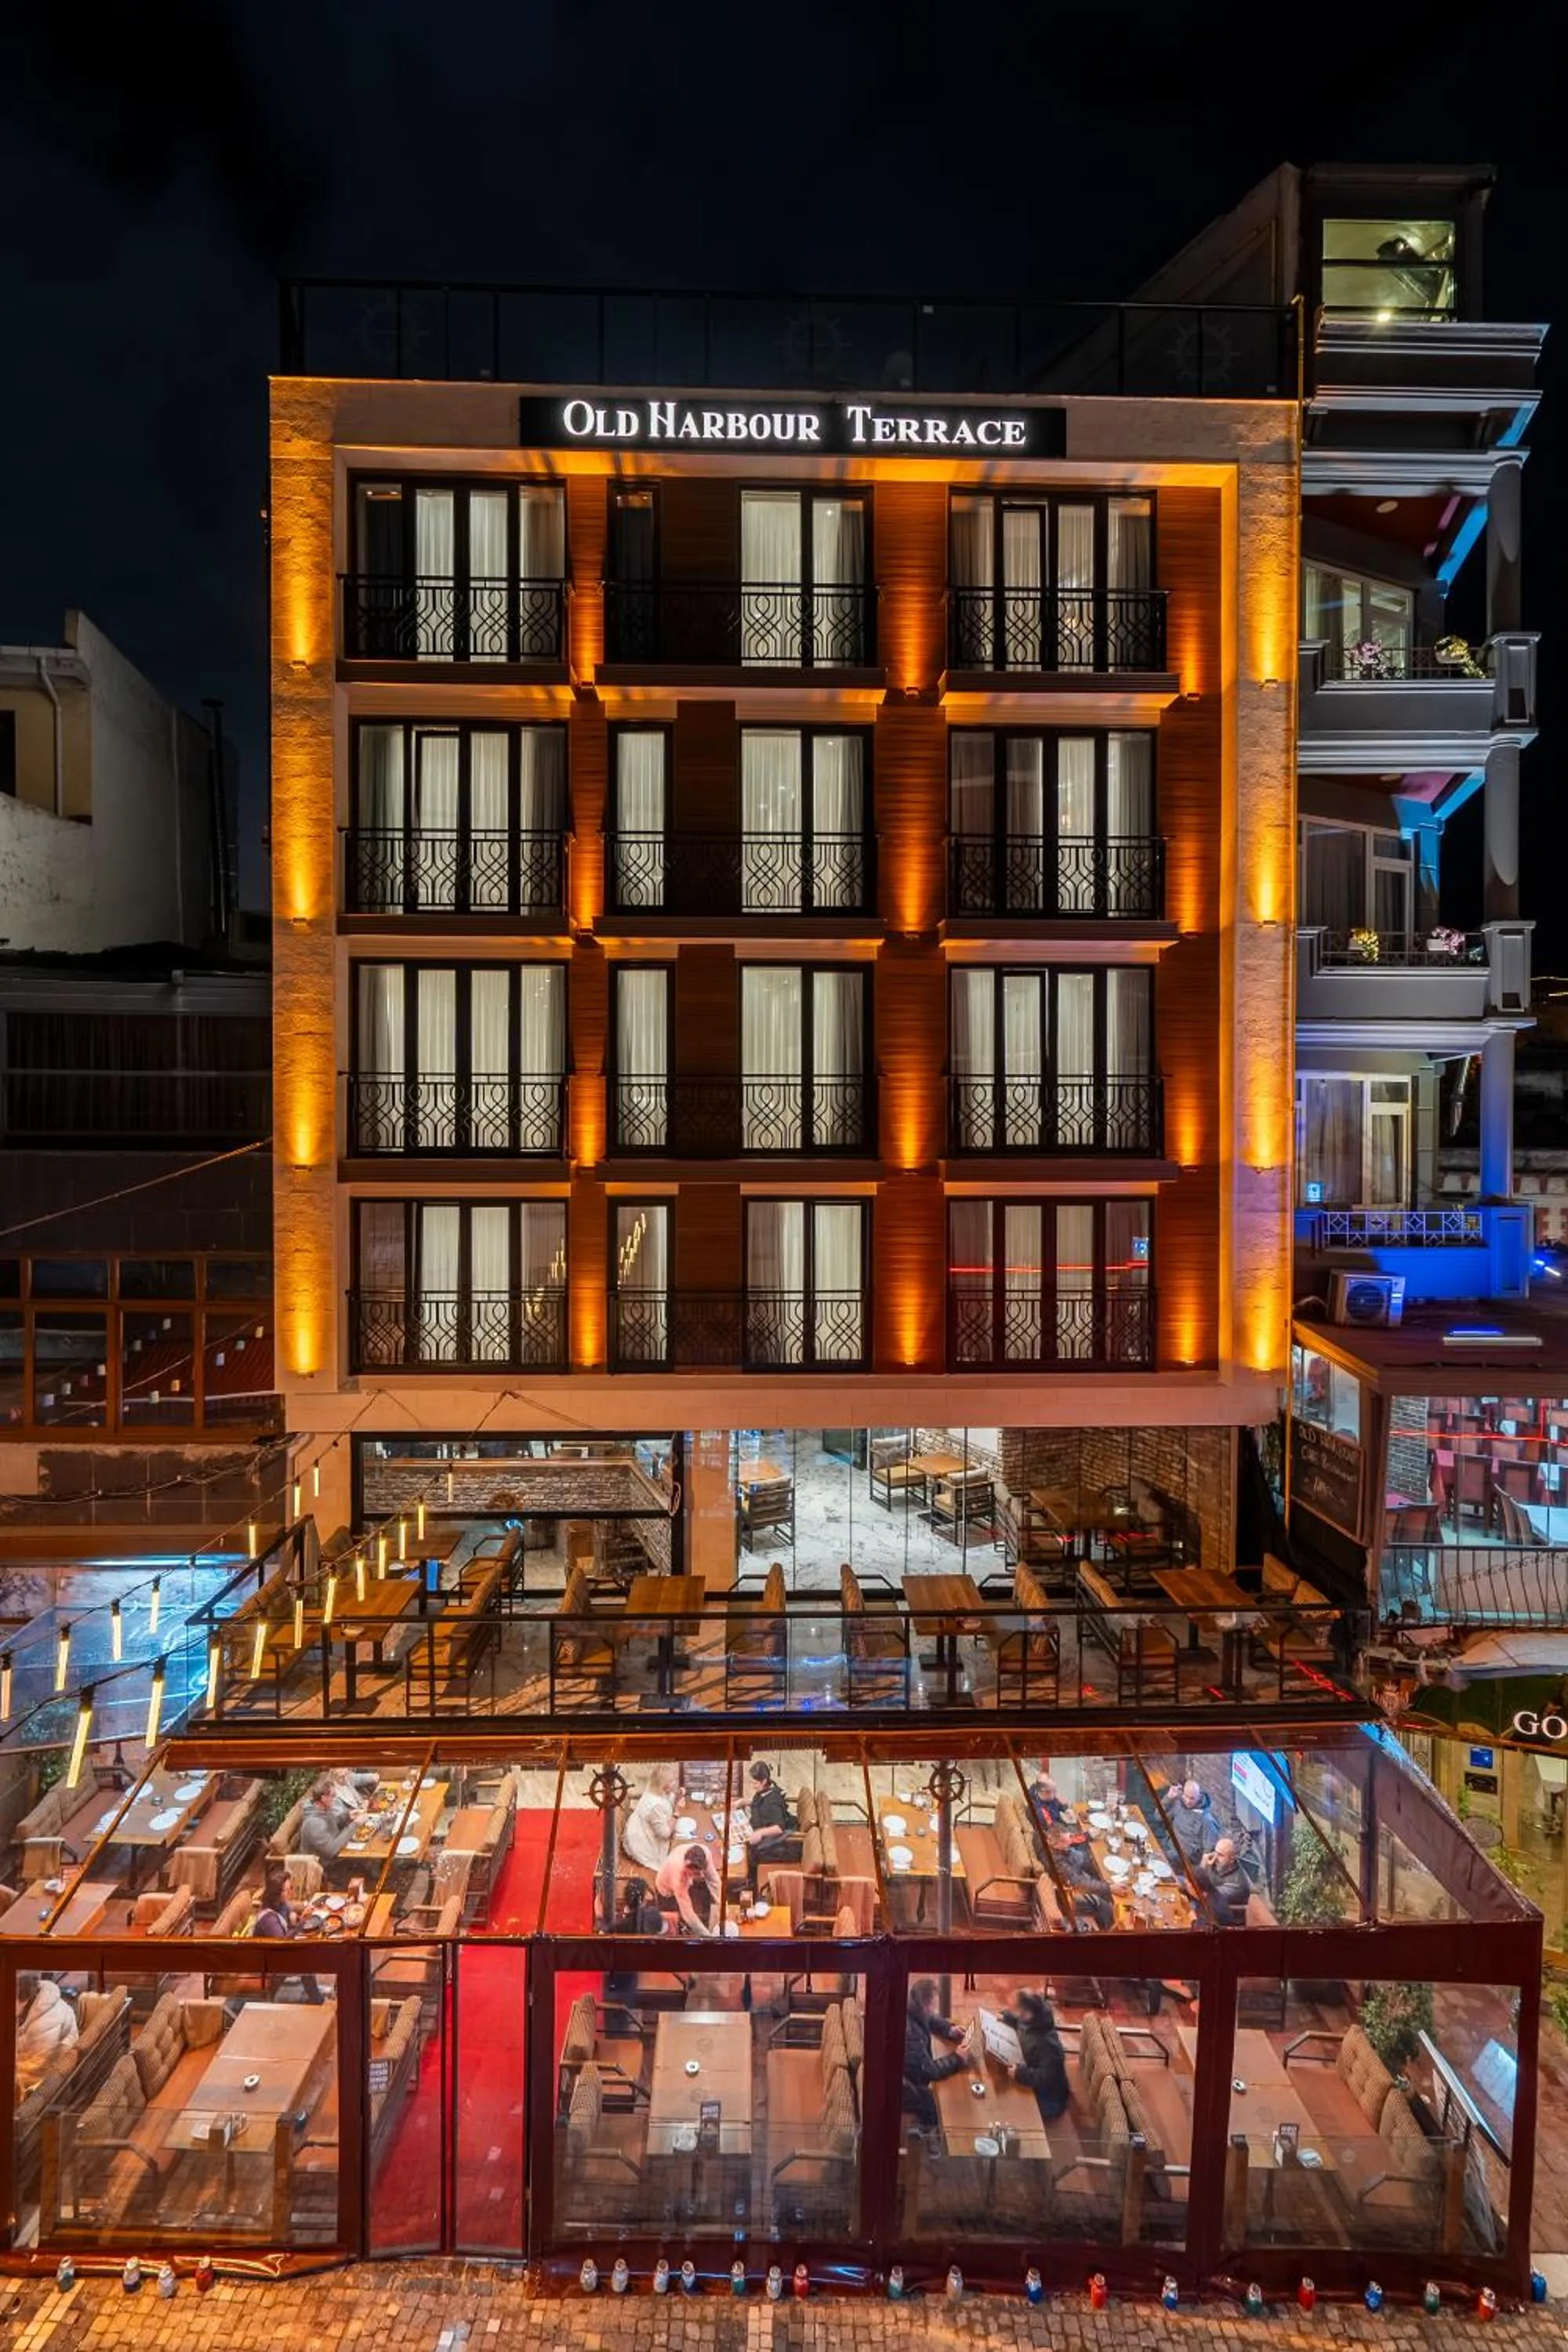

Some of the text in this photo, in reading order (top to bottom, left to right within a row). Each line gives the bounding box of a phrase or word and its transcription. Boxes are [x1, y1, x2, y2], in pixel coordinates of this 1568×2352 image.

[562, 400, 1027, 445] OLD HARBOUR TERRACE
[1513, 1711, 1567, 1740] GO
